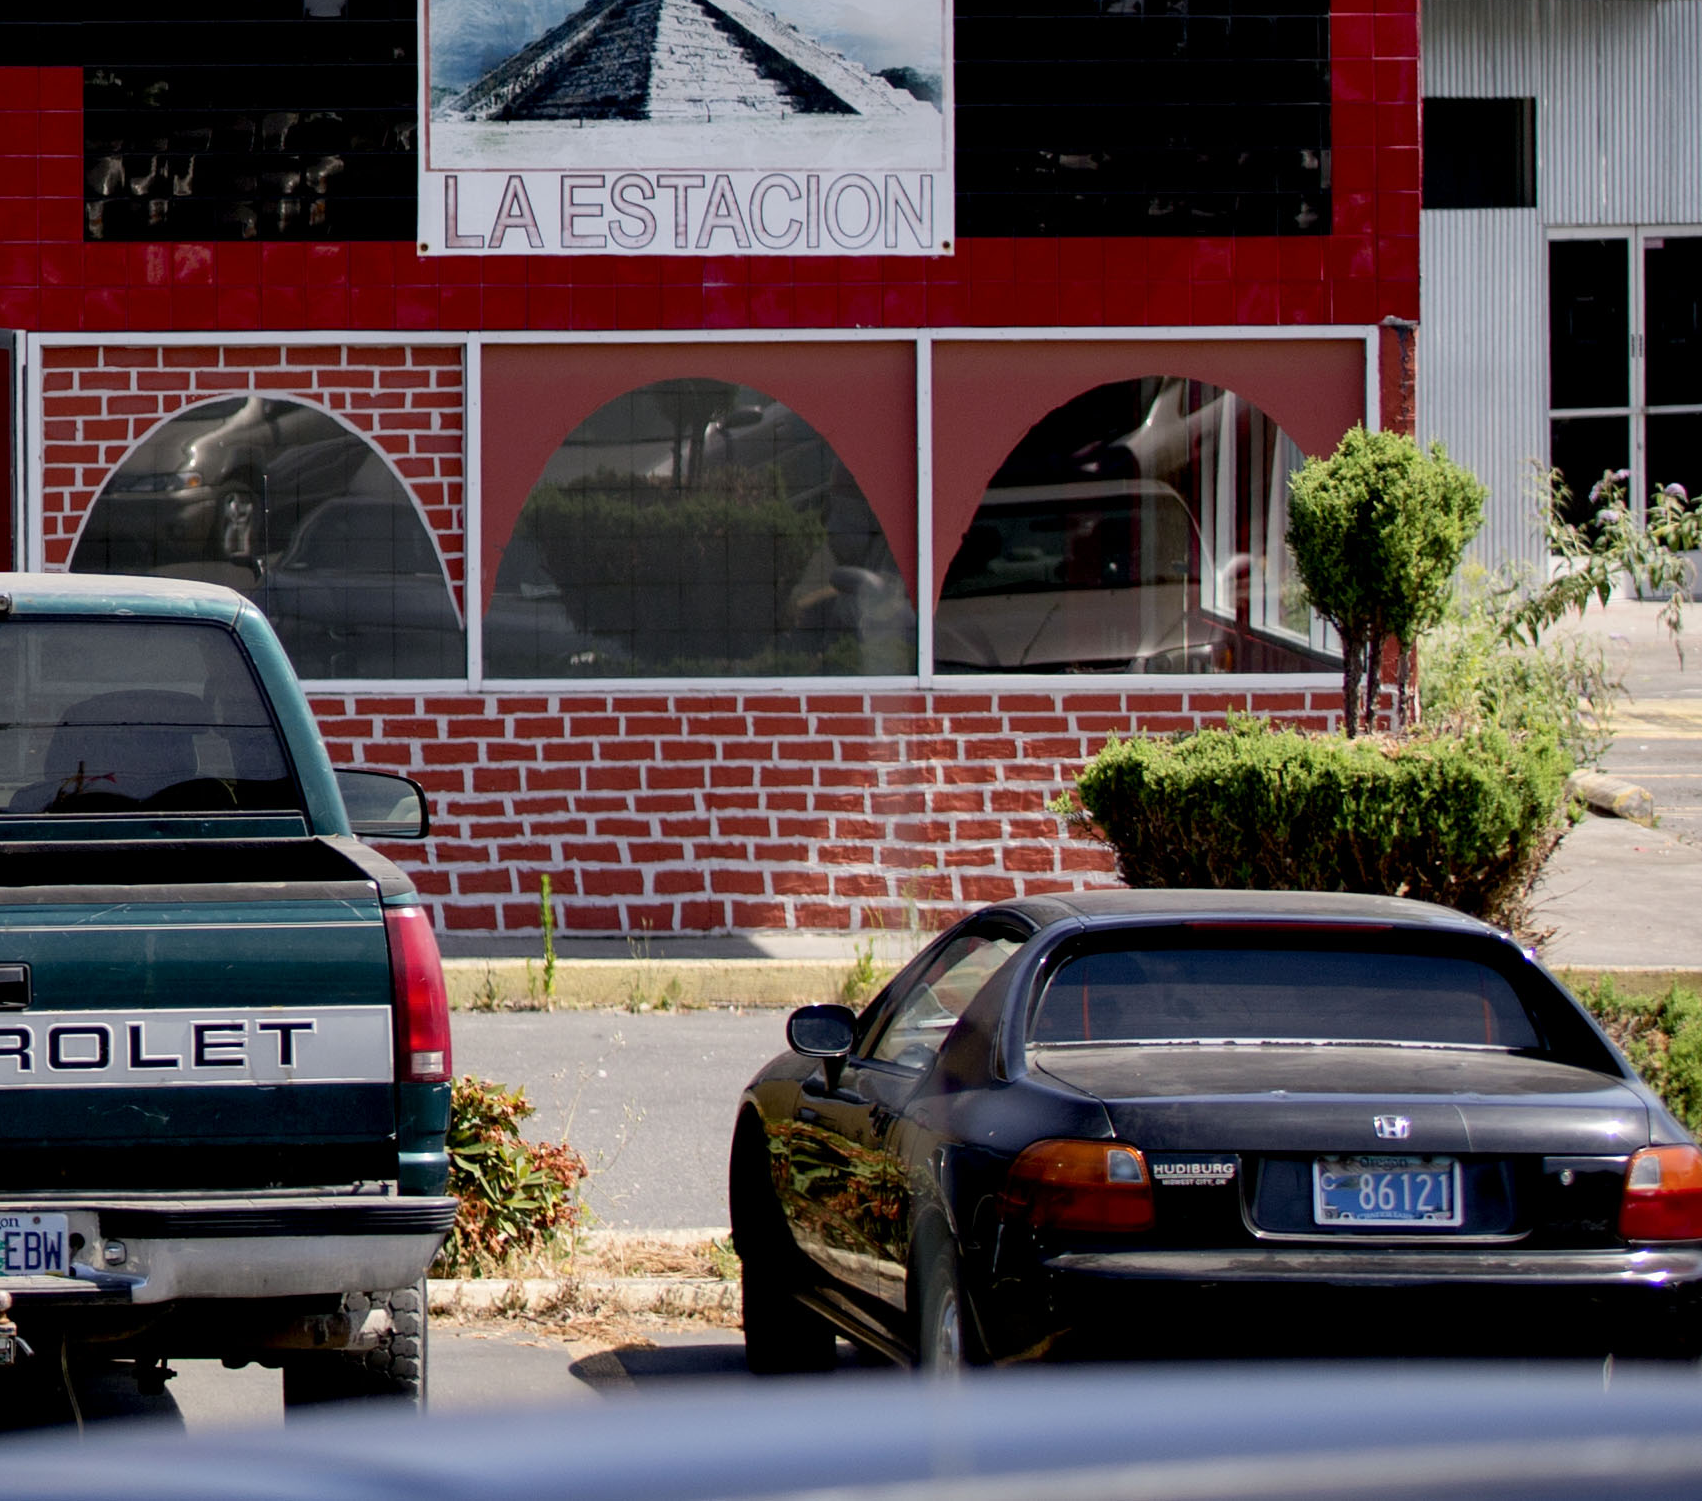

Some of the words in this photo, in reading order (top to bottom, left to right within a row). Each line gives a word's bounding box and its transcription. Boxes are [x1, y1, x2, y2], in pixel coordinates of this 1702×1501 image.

[444, 174, 544, 250] LA
[560, 173, 934, 250] ESTACION
[1153, 1163, 1235, 1174] HUDIBURG
[1359, 1173, 1452, 1211] 86121
[5, 1231, 62, 1271] EBW
